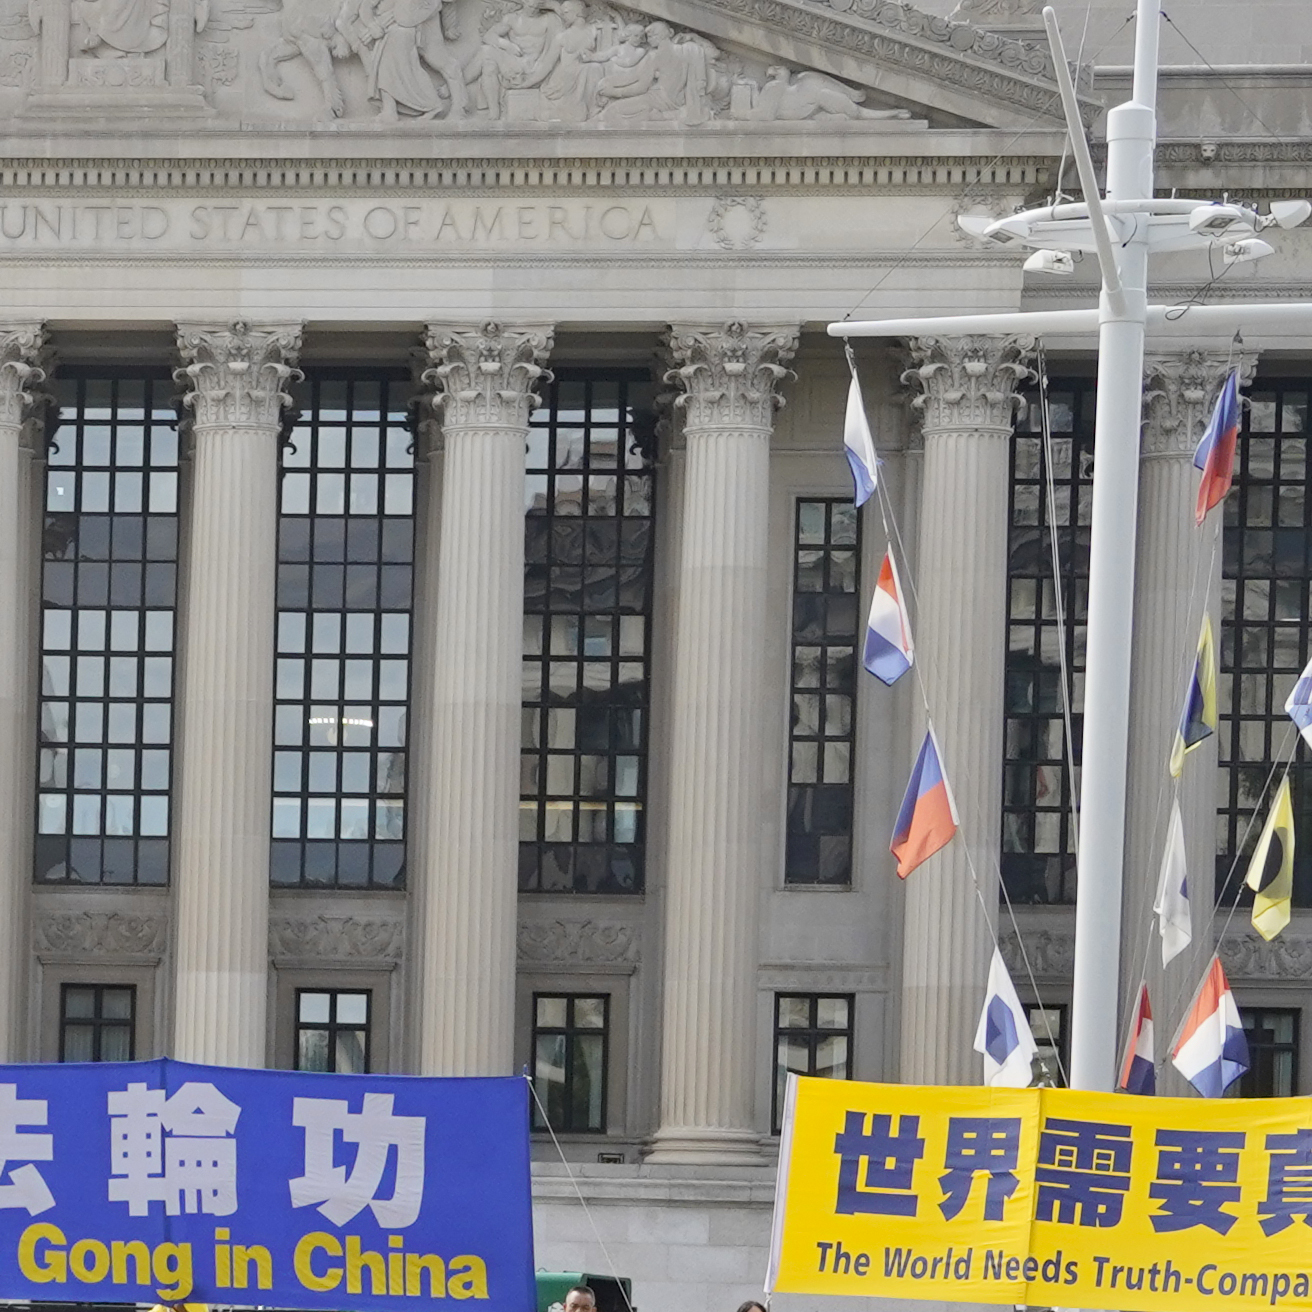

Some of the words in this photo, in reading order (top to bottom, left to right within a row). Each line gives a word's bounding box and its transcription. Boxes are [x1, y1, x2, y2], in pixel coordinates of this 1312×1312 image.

[189, 205, 350, 242] STATES
[362, 205, 425, 242] OF
[435, 205, 664, 242] AMERICA
[17, 1222, 194, 1302] Gong
[214, 1226, 274, 1291] in
[293, 1230, 490, 1301] China
[816, 1241, 871, 1276] The
[883, 1245, 974, 1282] World
[983, 1249, 1079, 1286] Needs
